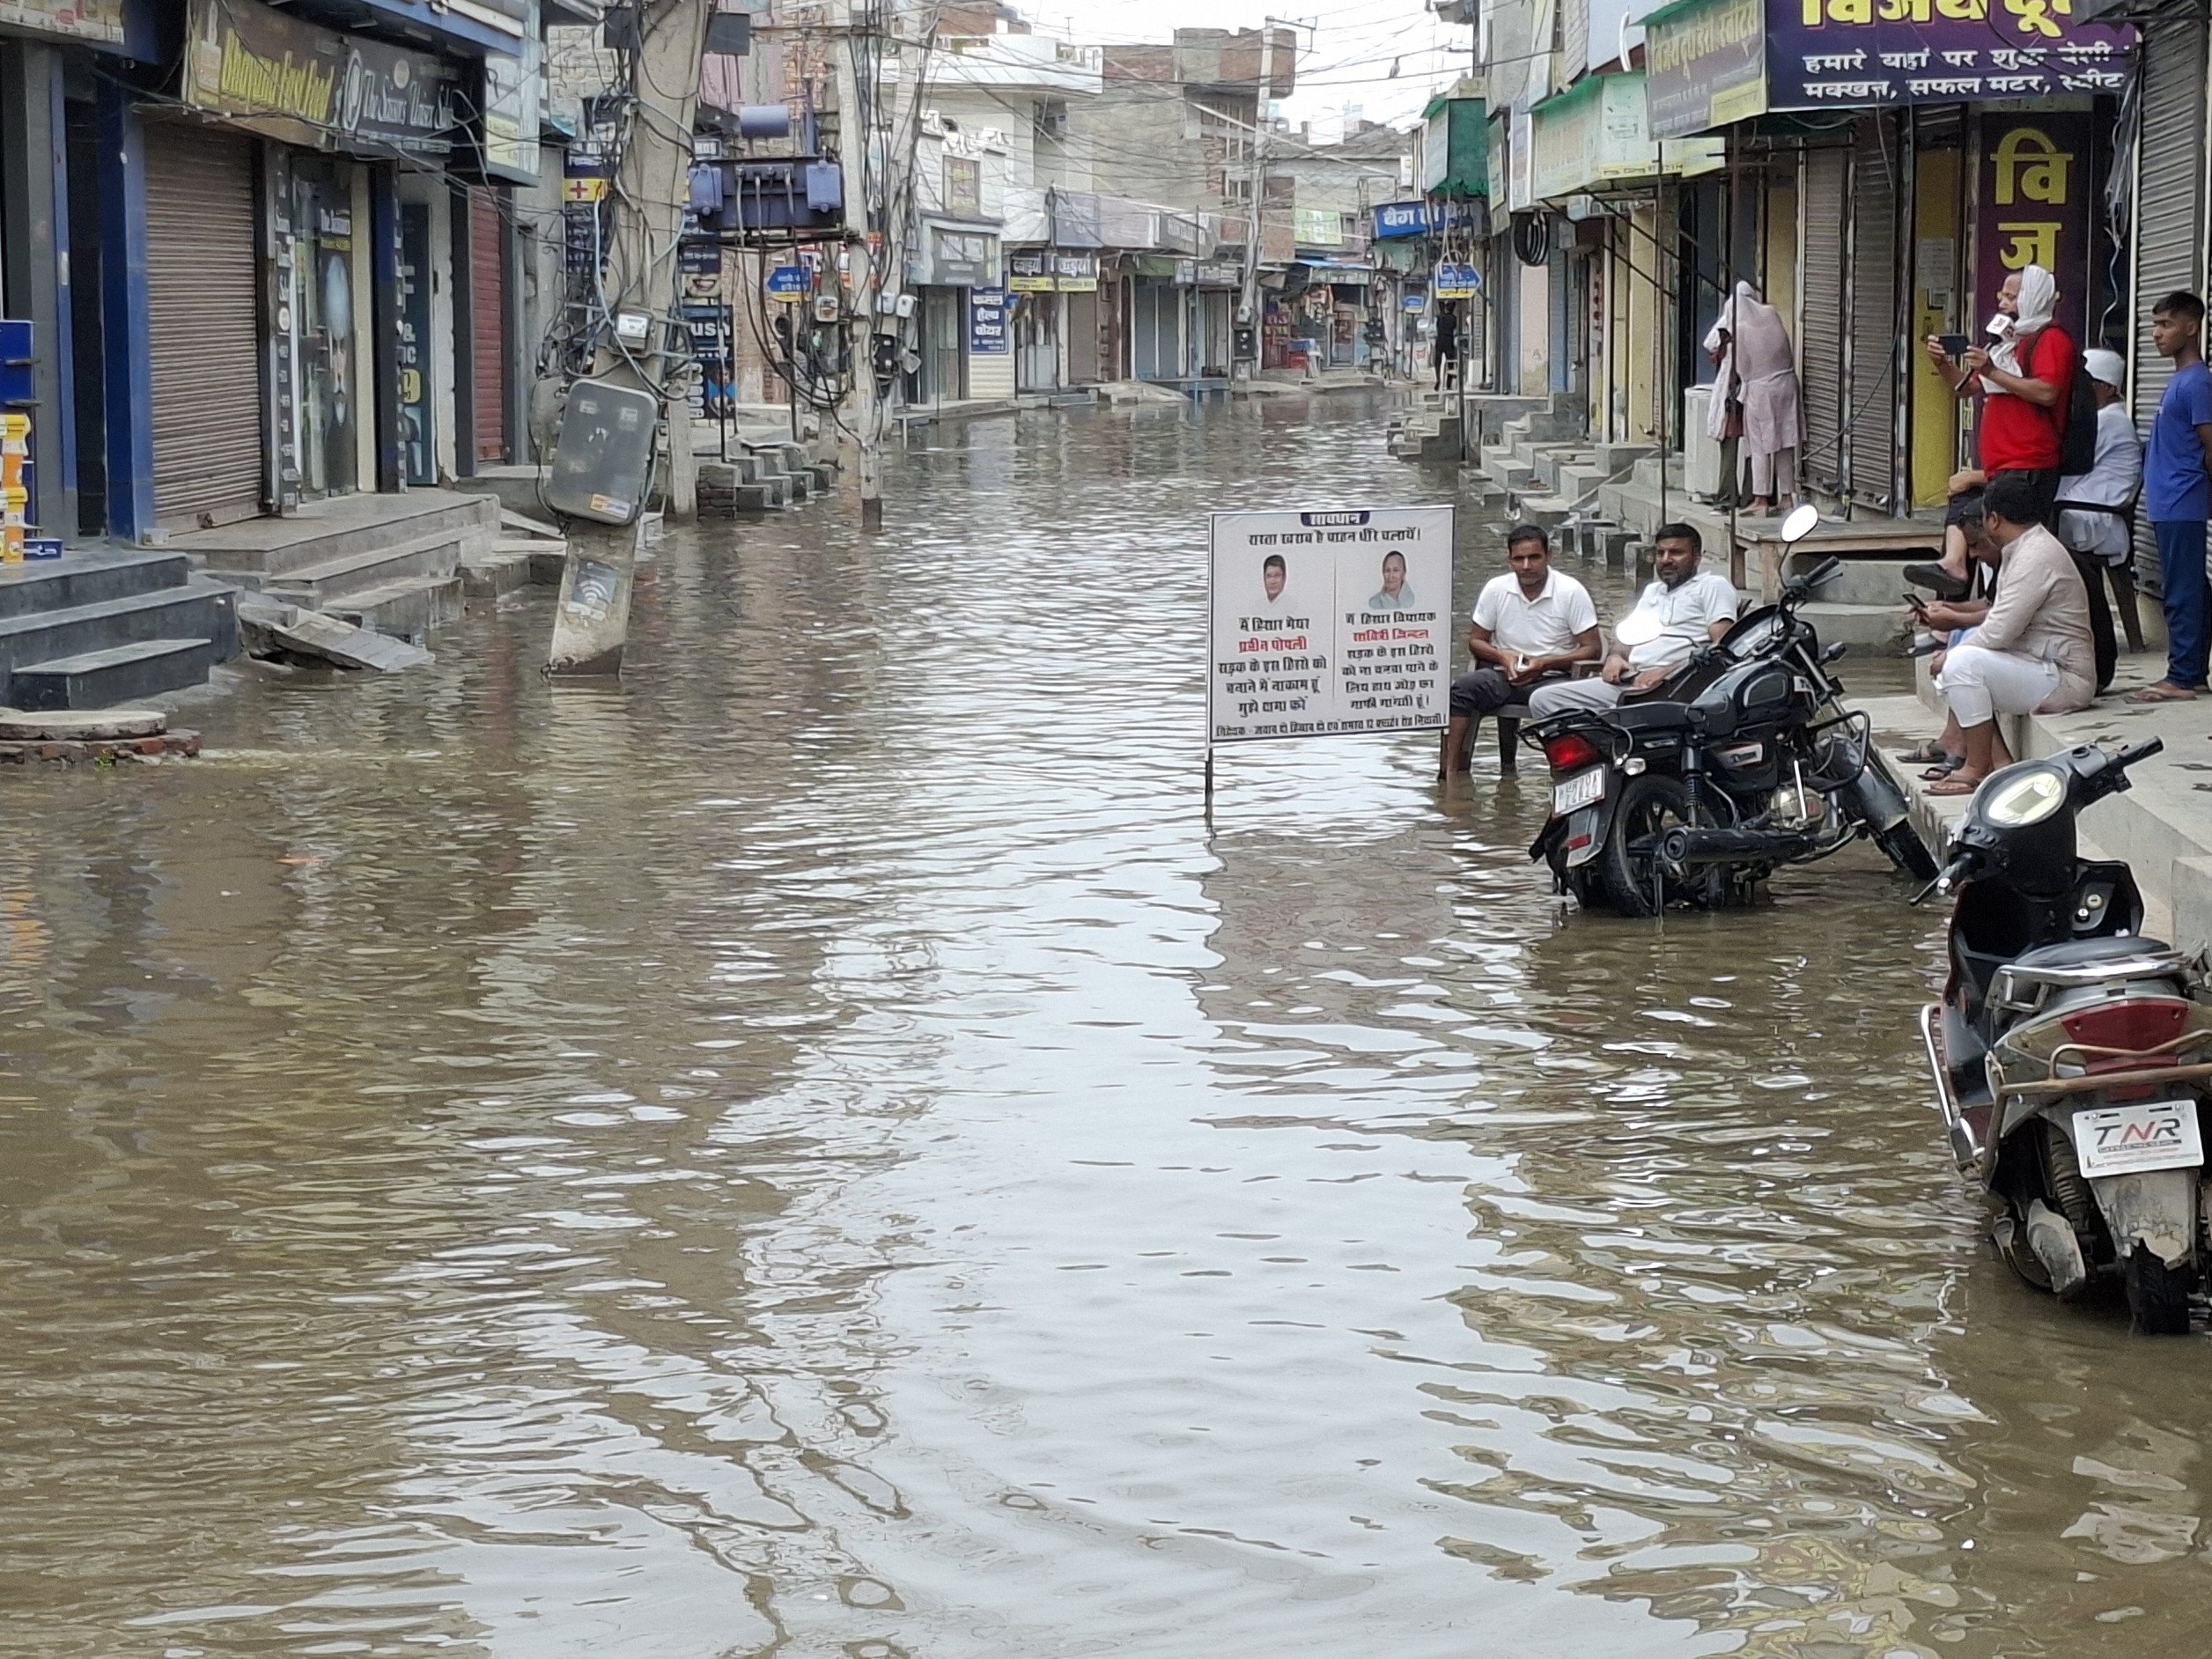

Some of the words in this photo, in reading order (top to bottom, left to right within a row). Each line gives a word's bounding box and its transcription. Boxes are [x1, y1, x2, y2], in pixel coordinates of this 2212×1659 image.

[1803, 48, 1867, 74] हमारे
[1942, 50, 1979, 67] पर
[1906, 77, 1981, 95] सफल
[1987, 76, 2051, 97] मटर,
[2095, 1118, 2180, 1146] TNR
